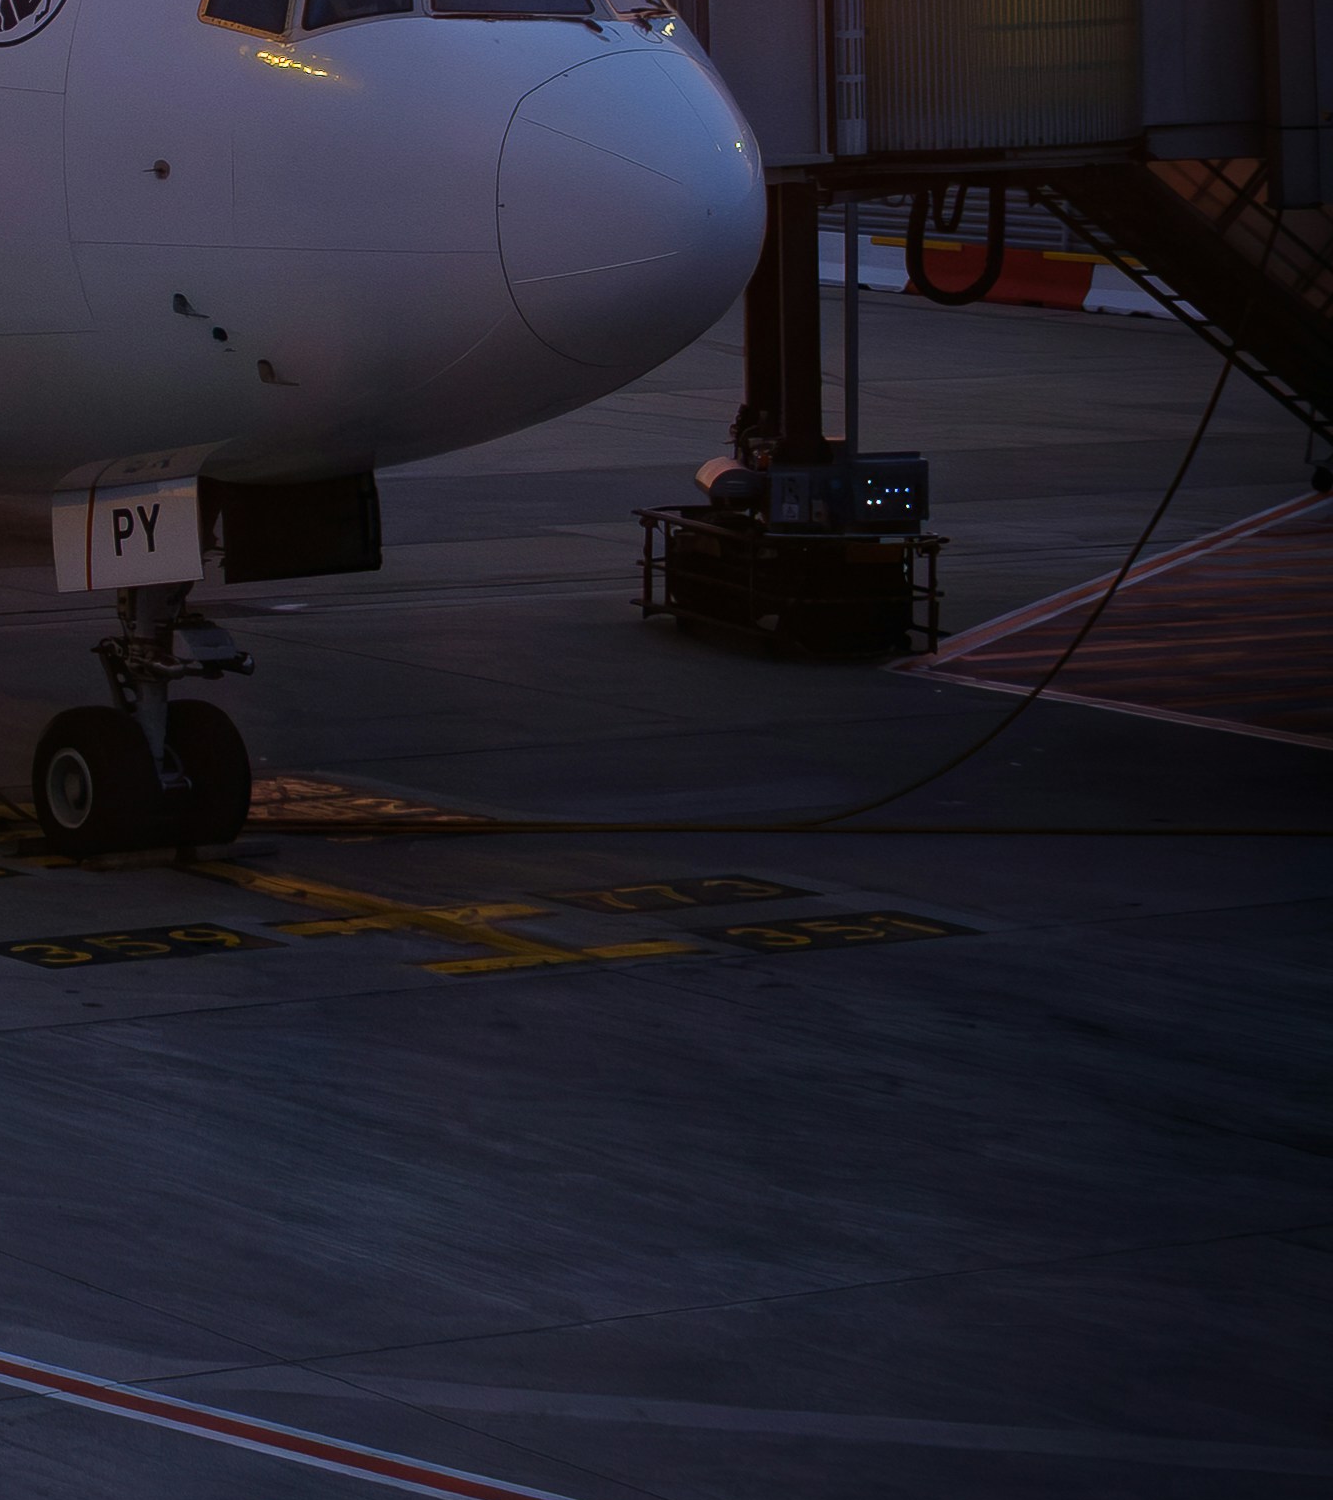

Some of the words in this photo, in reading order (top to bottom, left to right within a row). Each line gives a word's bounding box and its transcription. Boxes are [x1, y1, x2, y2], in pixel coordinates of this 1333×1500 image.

[113, 503, 160, 556] PY
[10, 927, 242, 963] 359
[727, 915, 948, 947] 351
